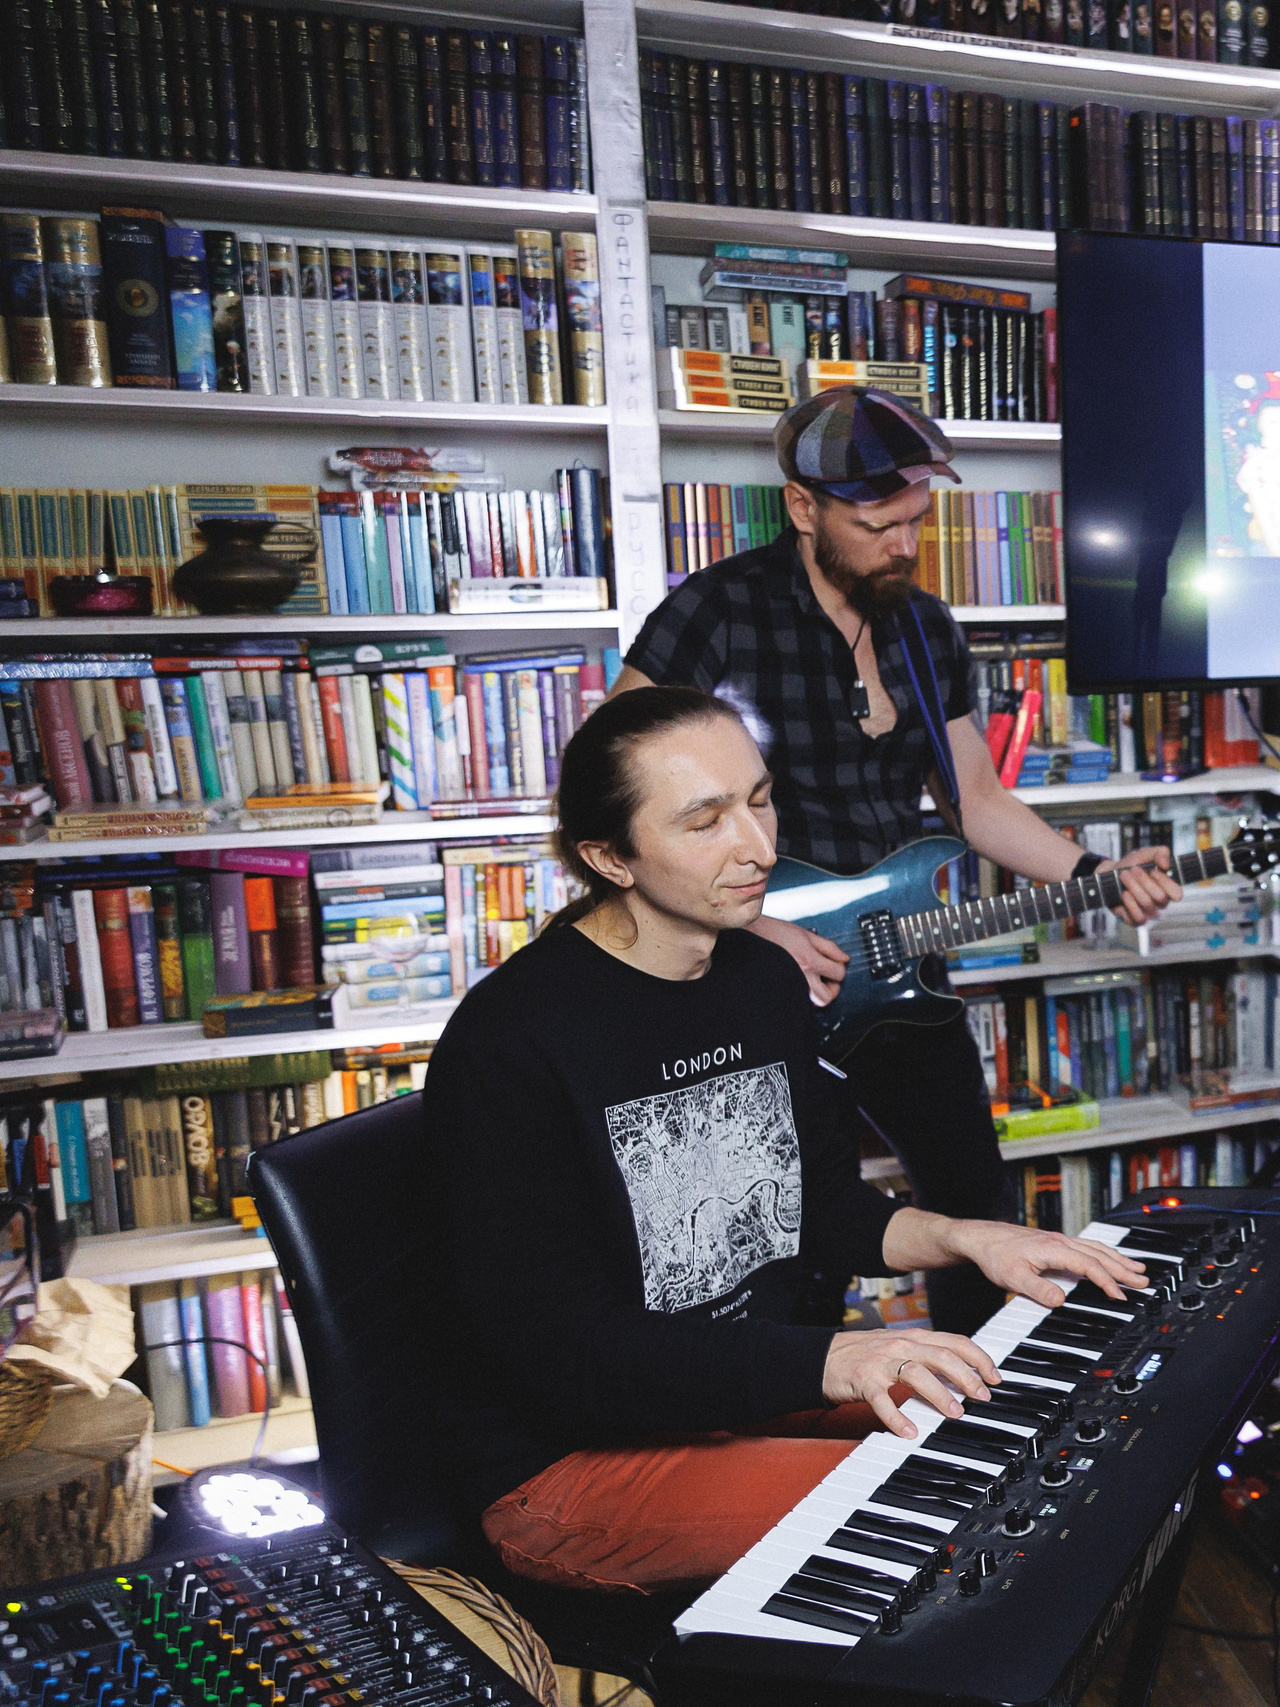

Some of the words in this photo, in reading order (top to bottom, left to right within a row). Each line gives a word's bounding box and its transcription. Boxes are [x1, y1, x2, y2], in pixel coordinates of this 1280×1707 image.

[733, 358, 760, 373] СТИВЕН
[762, 360, 781, 374] КИНГ
[662, 1042, 742, 1080] LONDON
[1084, 1489, 1099, 1503] FILTER
[1001, 1578, 1013, 1590] LFO
